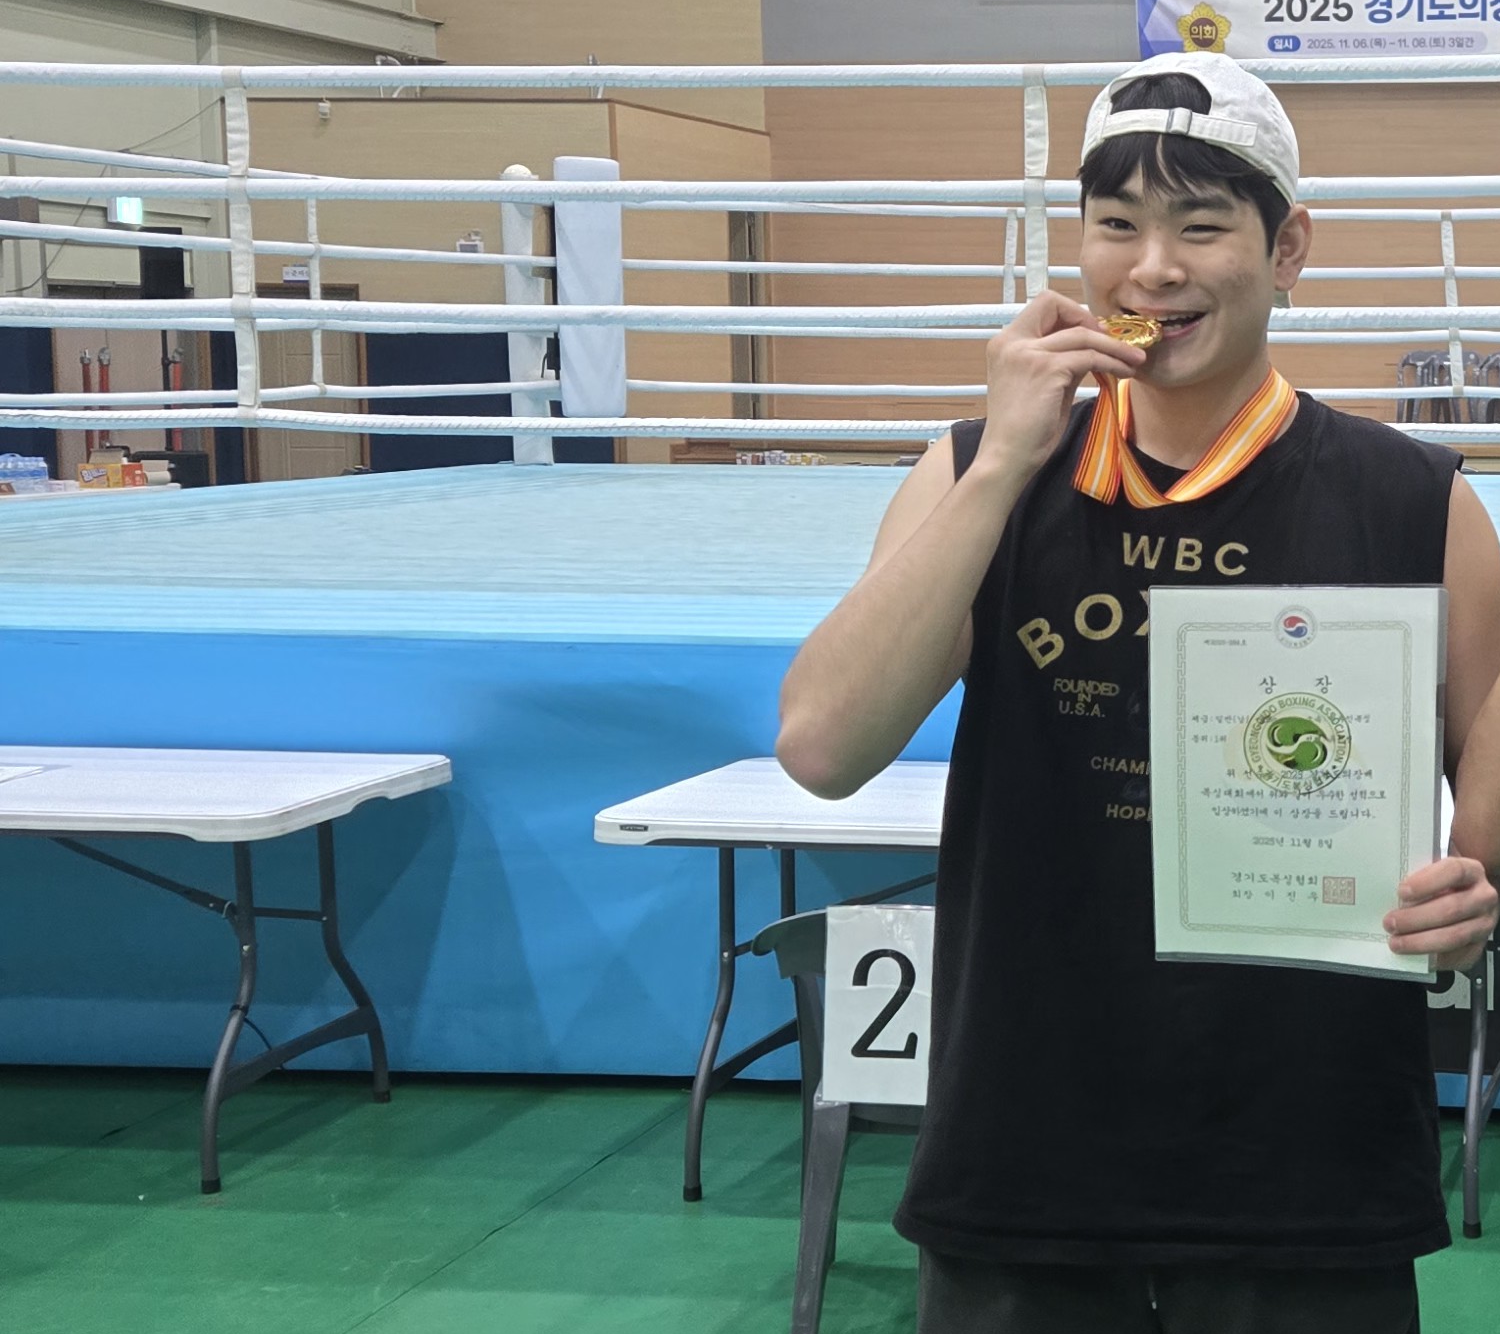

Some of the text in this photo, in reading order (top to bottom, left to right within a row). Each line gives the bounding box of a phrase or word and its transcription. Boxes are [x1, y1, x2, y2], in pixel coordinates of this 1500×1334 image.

[1190, 23, 1217, 40] 의회
[1273, 38, 1293, 50] 일시
[1122, 531, 1250, 576] WBC
[1053, 678, 1120, 696] FOUNDED
[1058, 699, 1106, 718] U.S.A.
[1278, 697, 1316, 711] BOXING
[1106, 803, 1152, 822] HOP
[851, 948, 918, 1059] 2
